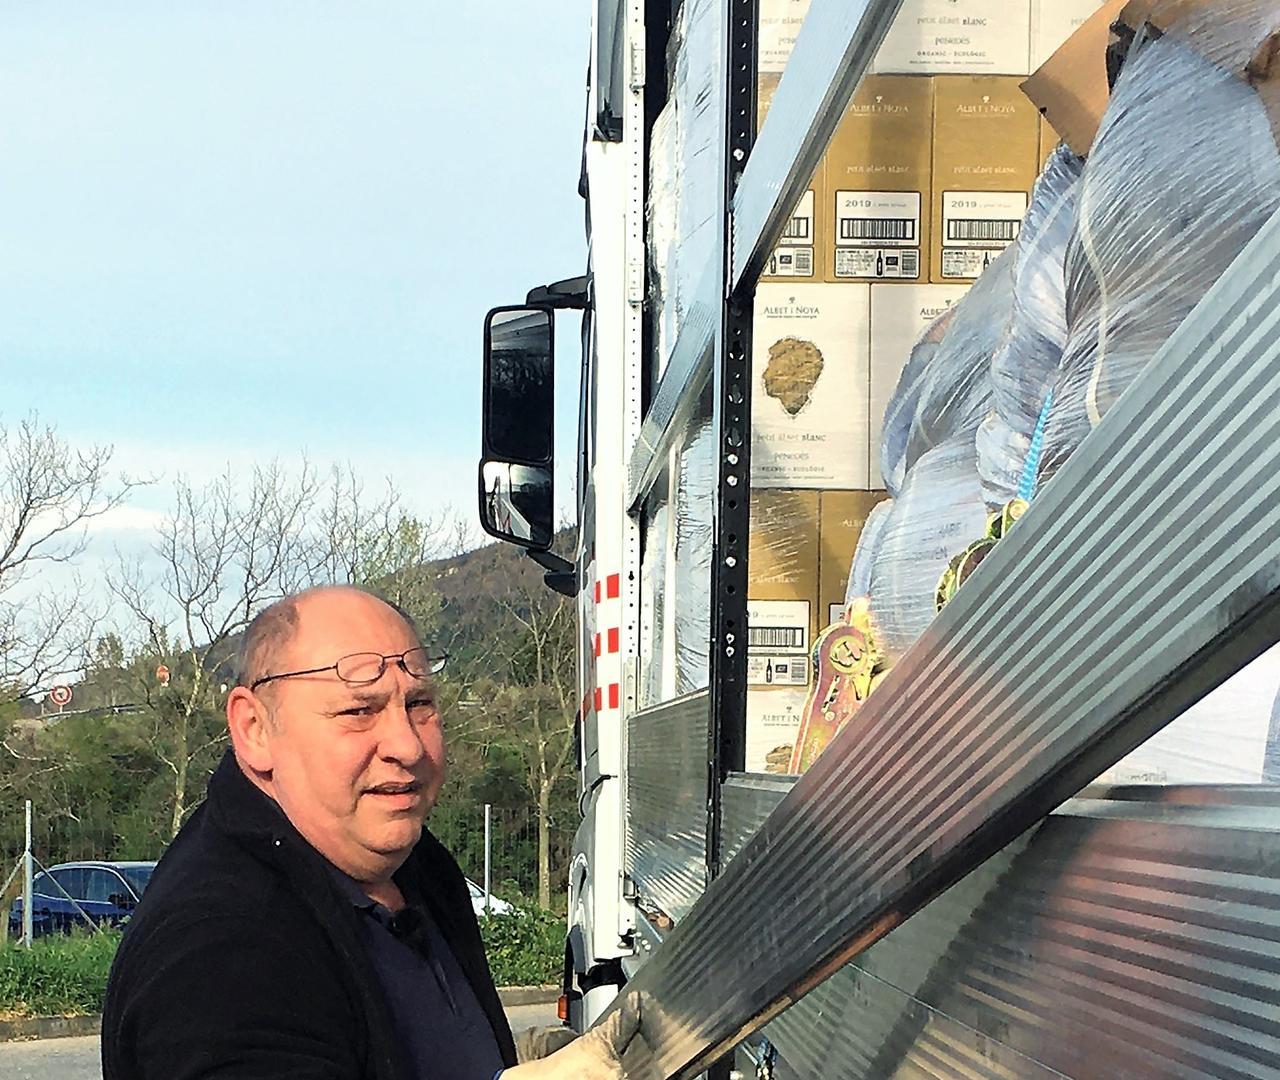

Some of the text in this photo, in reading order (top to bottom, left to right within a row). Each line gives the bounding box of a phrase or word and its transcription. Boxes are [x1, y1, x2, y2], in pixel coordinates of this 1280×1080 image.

[845, 199, 872, 208] 2019
[951, 200, 977, 209] 2019
[763, 305, 788, 315] ALBET
[795, 305, 820, 316] NOYA
